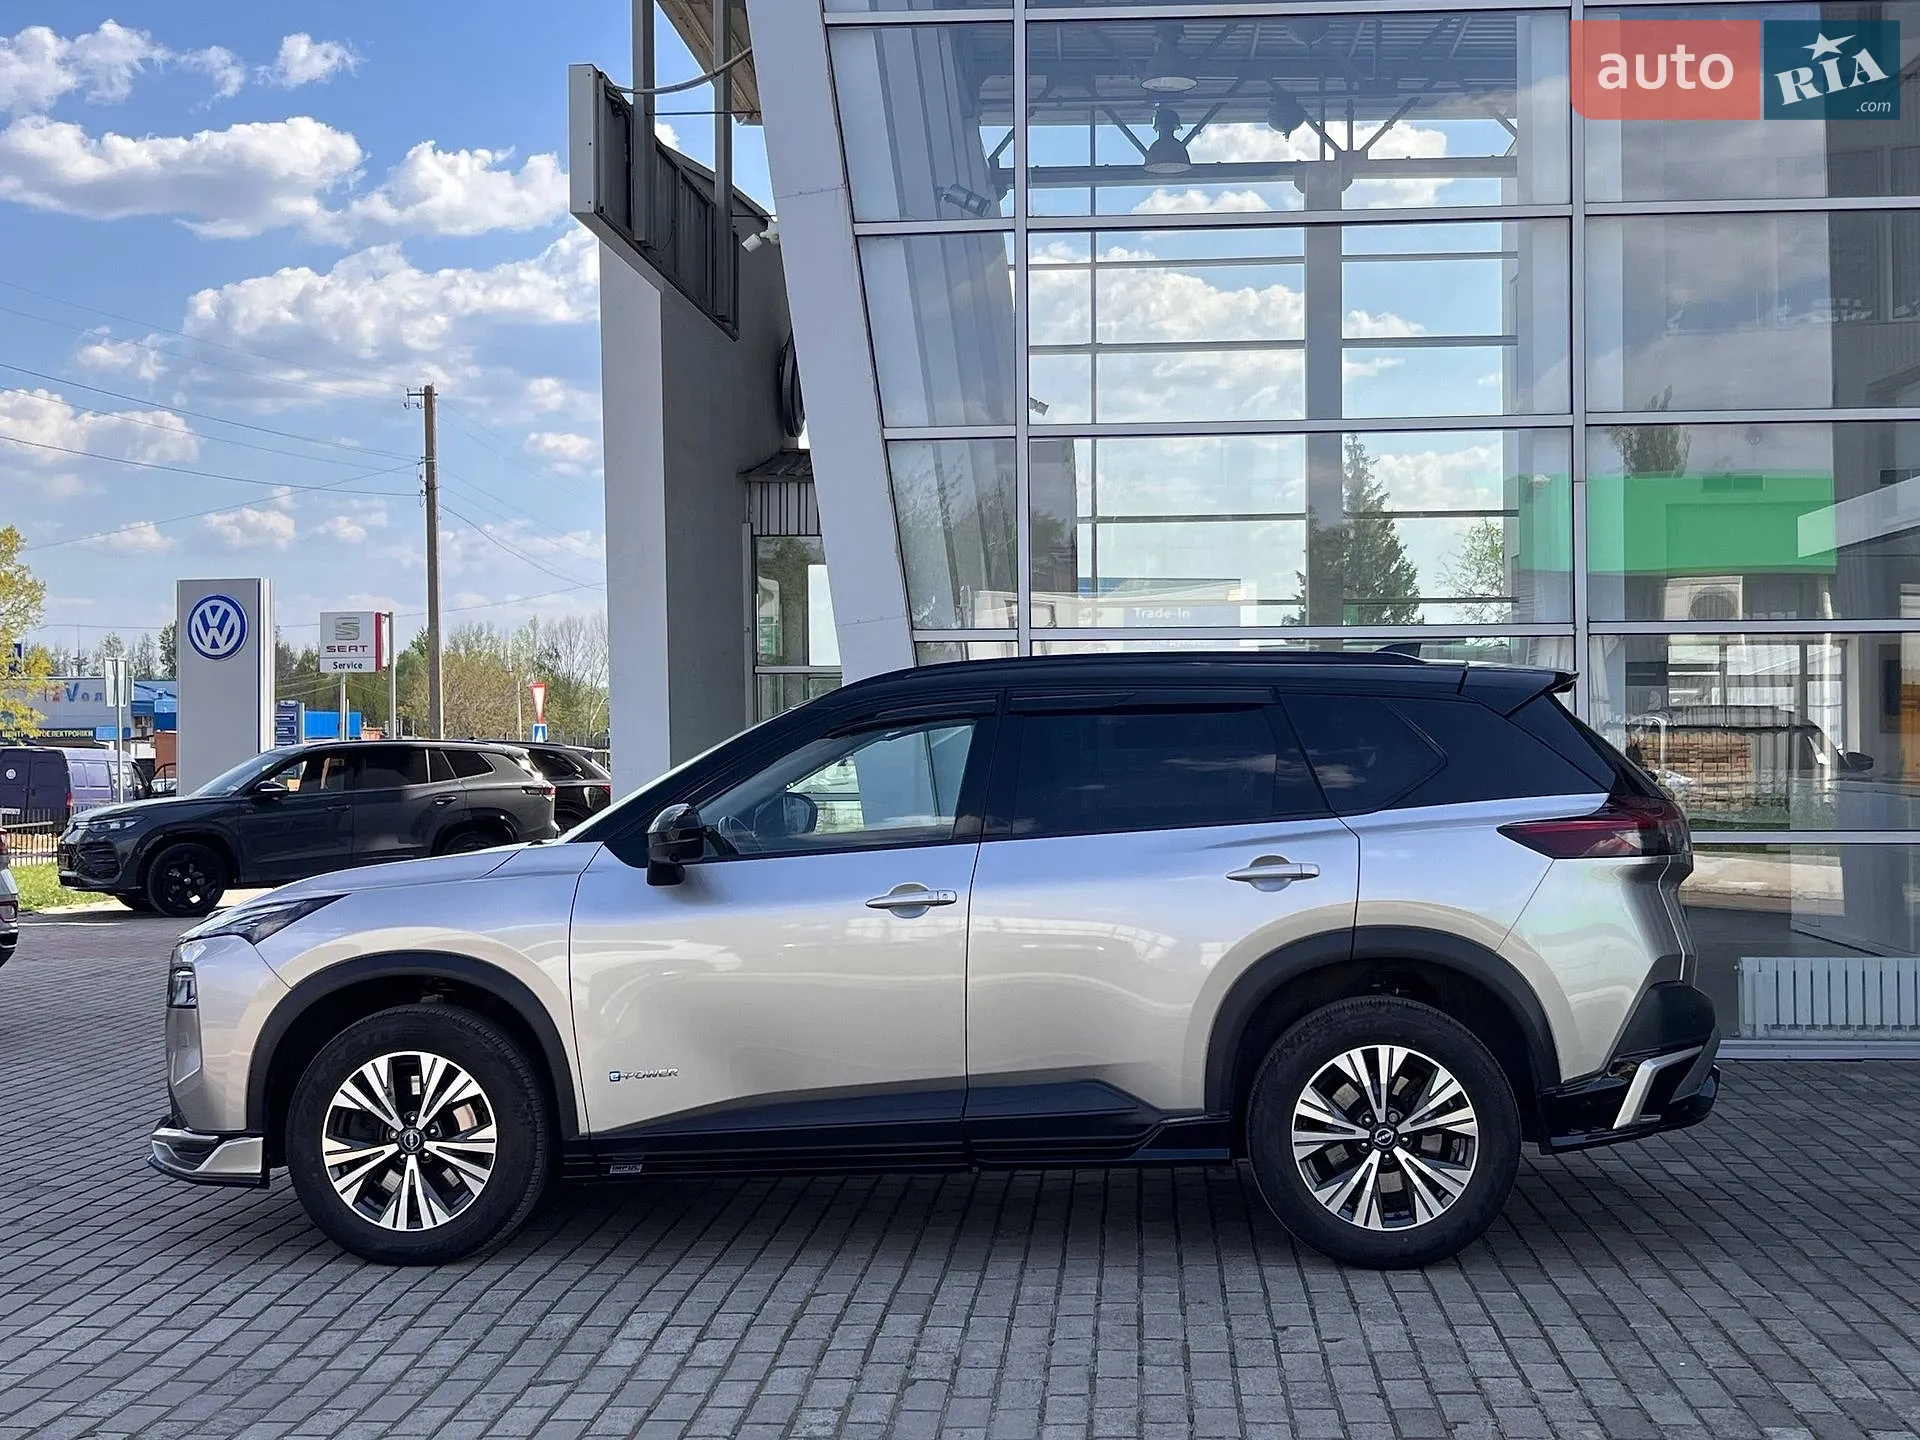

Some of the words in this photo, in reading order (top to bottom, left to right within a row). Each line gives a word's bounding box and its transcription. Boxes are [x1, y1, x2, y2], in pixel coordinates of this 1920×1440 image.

[1132, 607, 1190, 619] Trade-In
[326, 645, 369, 653] SEAT
[332, 661, 363, 670] Service
